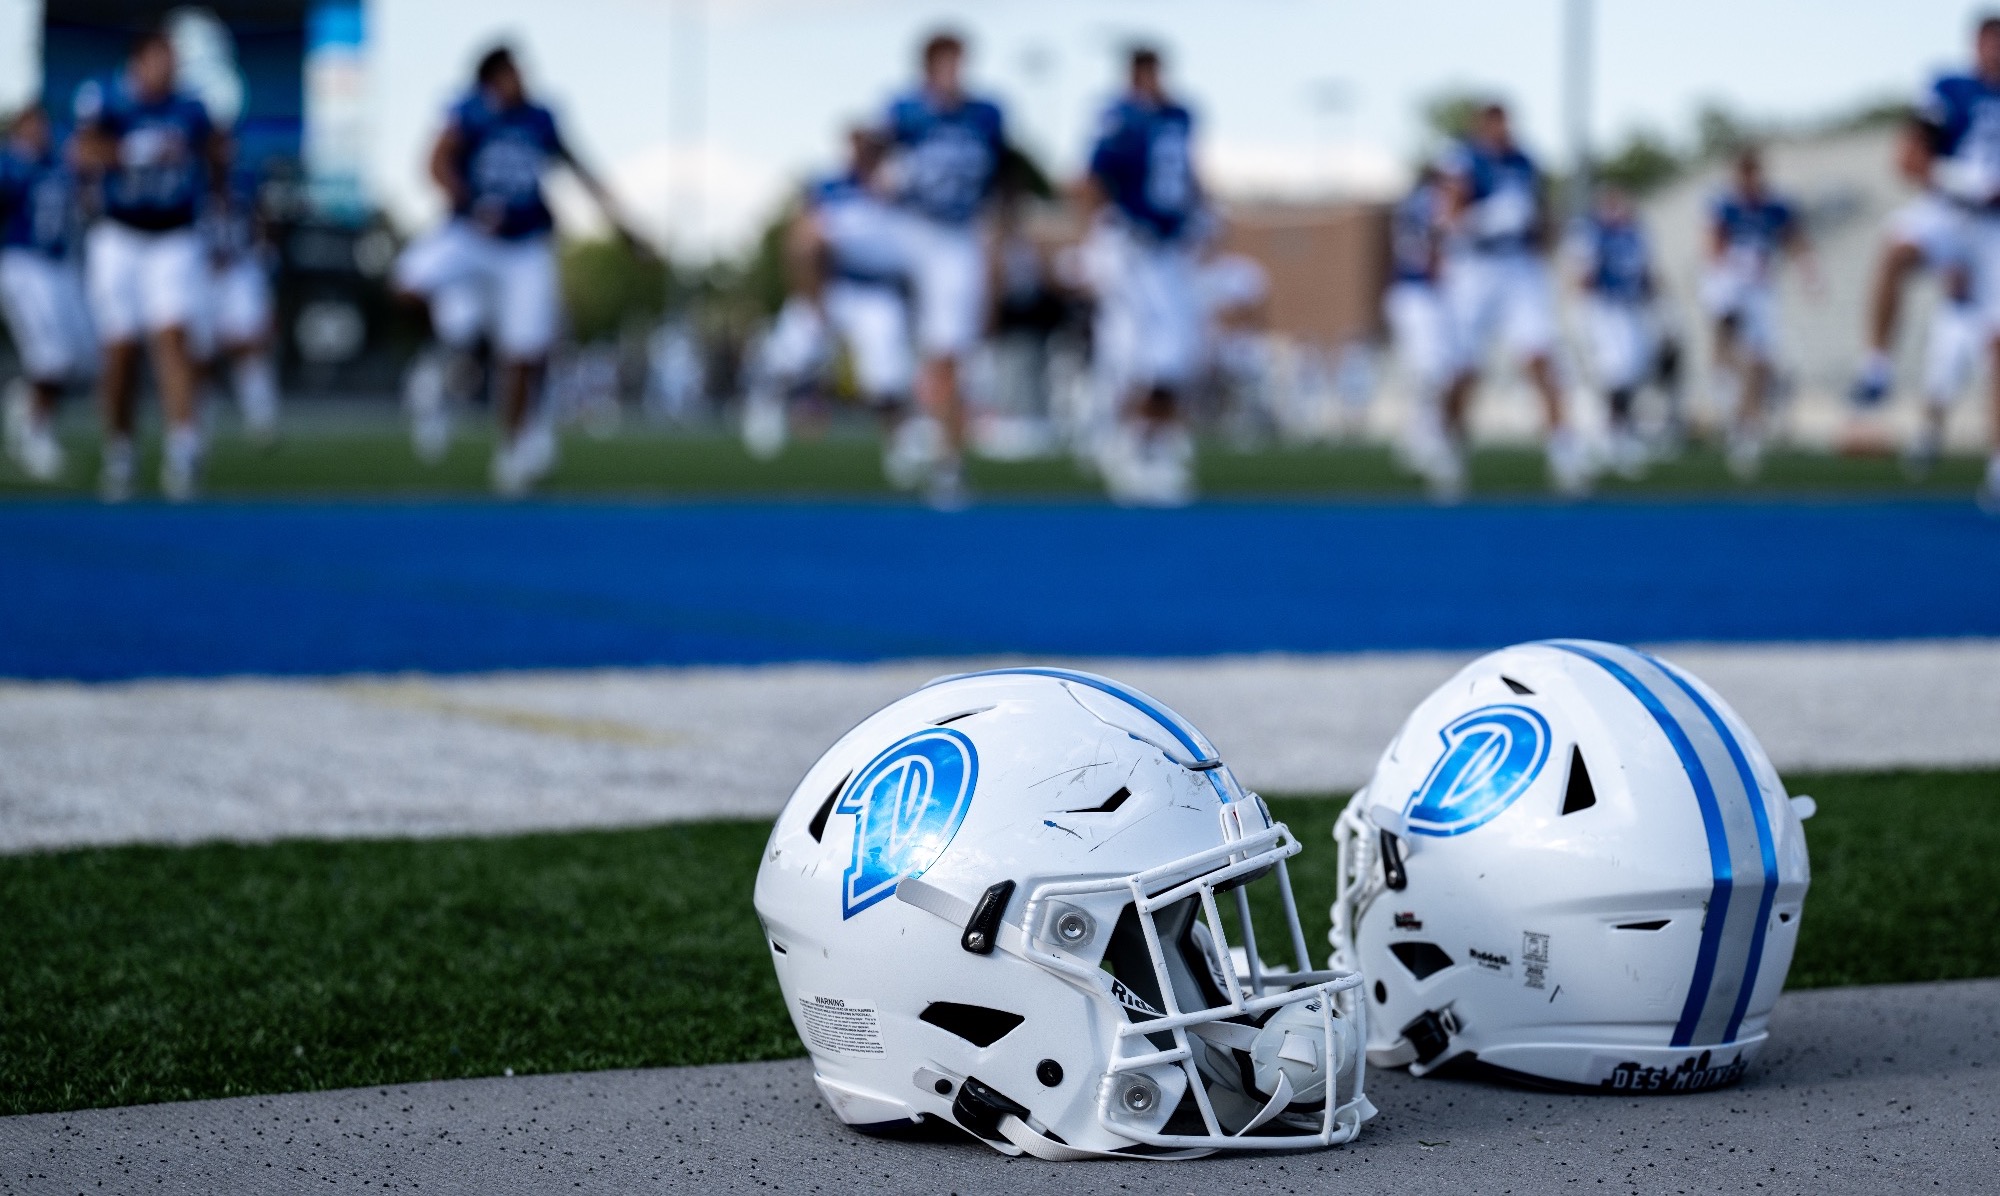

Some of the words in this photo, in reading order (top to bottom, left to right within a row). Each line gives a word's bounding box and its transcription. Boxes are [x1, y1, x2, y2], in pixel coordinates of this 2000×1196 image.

[1402, 704, 1552, 838] D
[836, 727, 979, 921] D
[814, 995, 845, 1007] WARNING
[1613, 1069, 1663, 1090] DES
